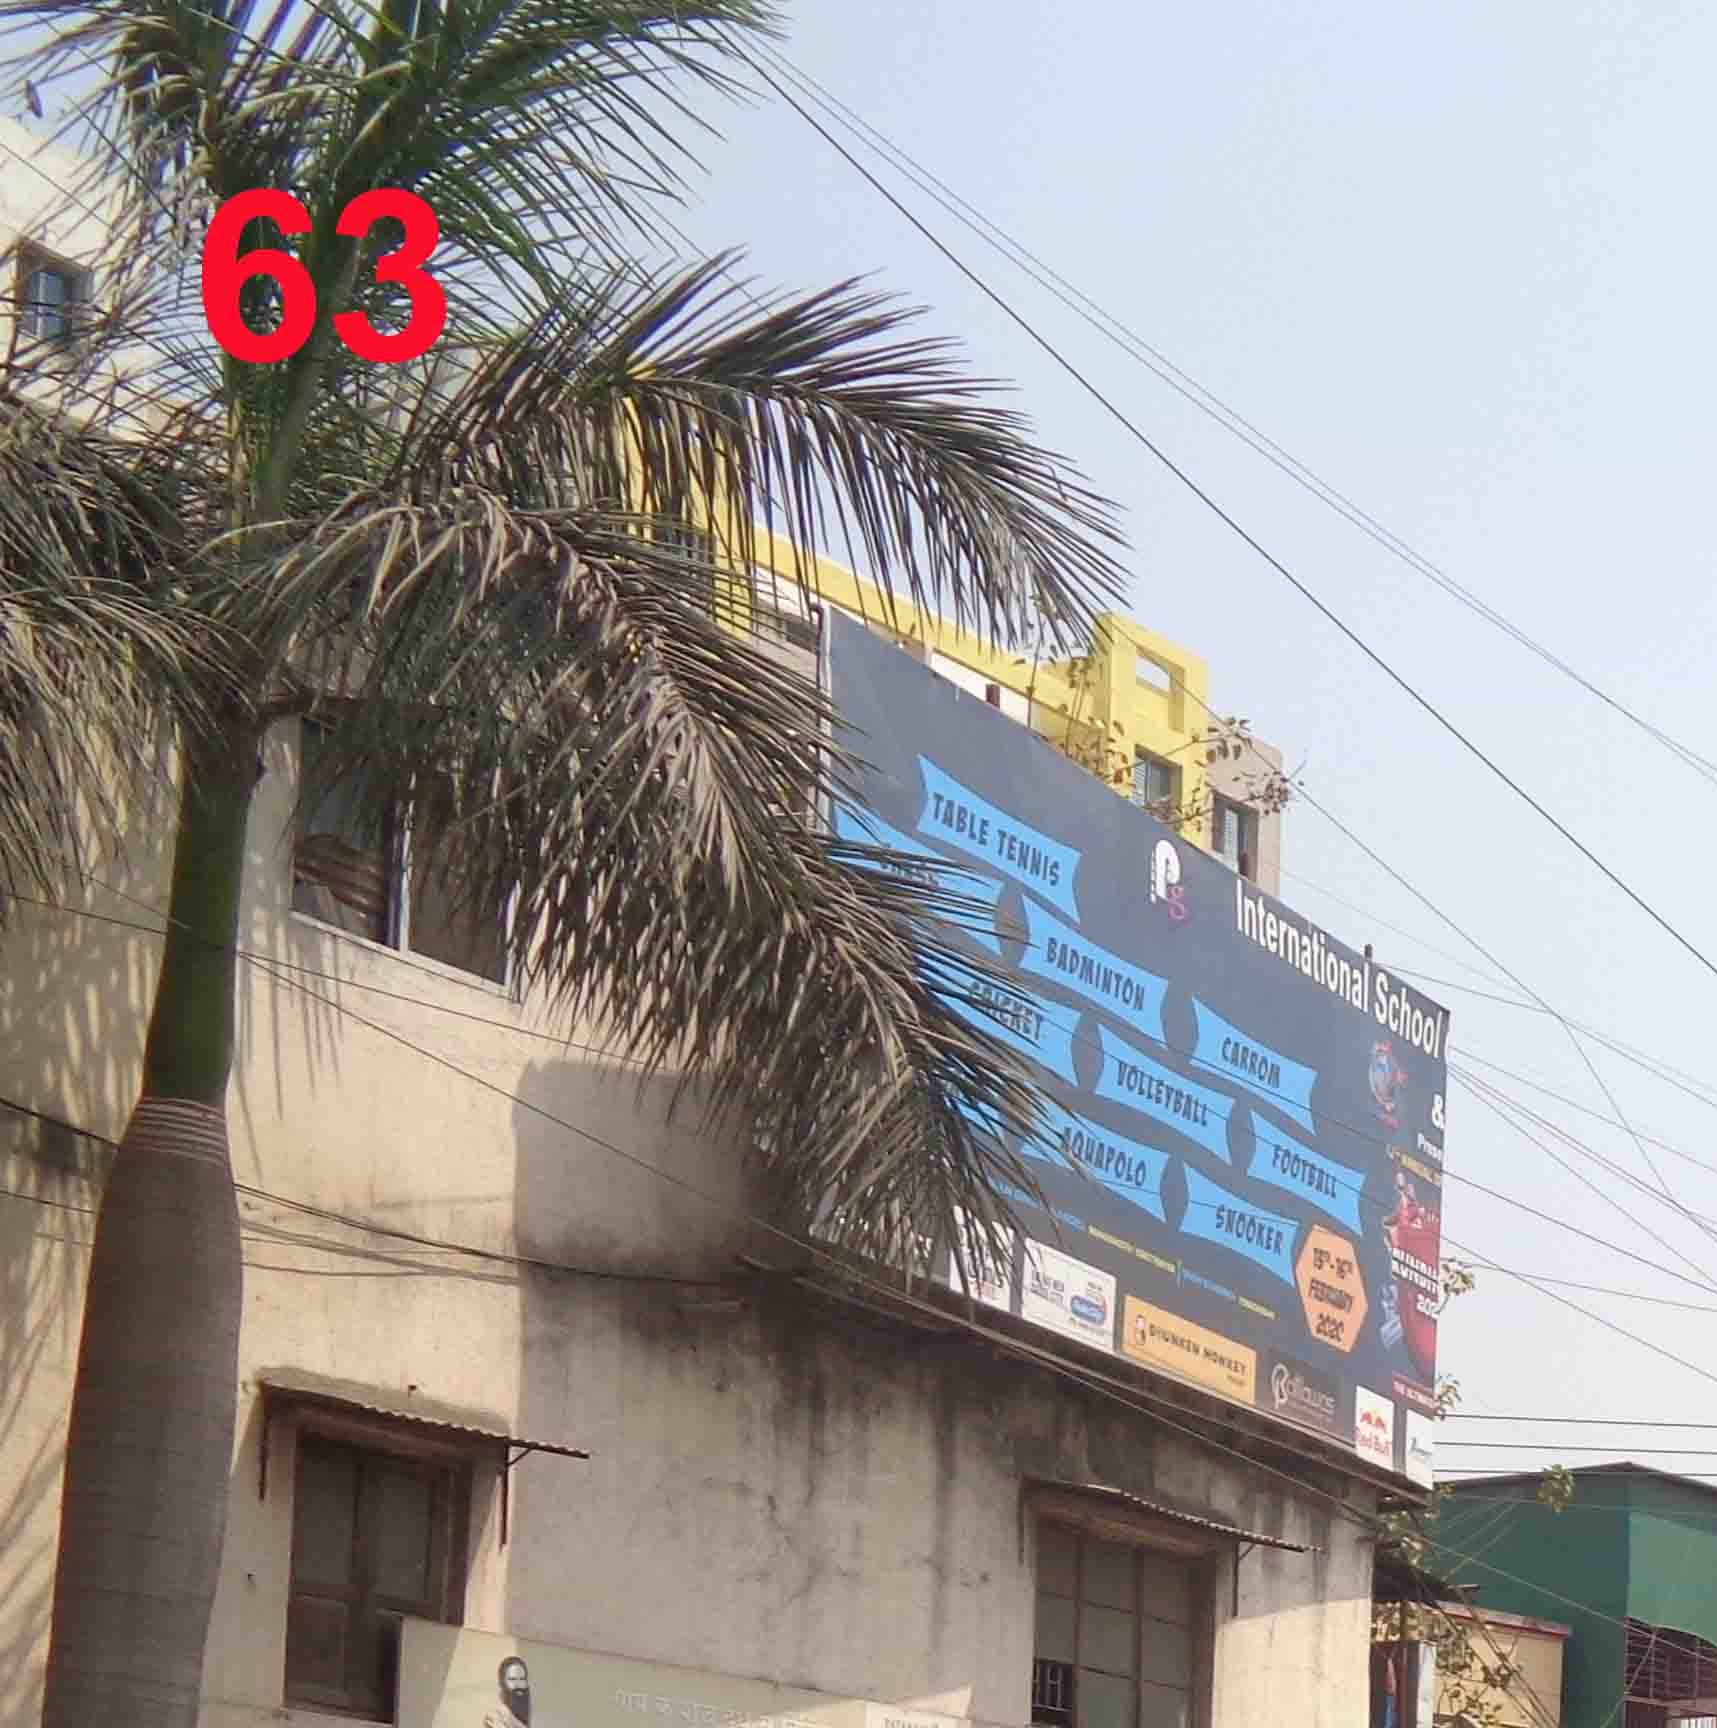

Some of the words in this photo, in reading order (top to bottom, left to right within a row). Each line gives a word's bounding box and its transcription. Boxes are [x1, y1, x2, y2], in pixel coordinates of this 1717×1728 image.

[932, 791, 989, 847] TABLE
[997, 829, 1061, 888] TENNIS
[1046, 936, 1146, 1014] BADMINTON
[1235, 879, 1369, 1014] International
[1374, 969, 1441, 1059] School
[1116, 1059, 1209, 1129] VOLLEYBALL
[1220, 1036, 1281, 1090] CARROM
[1062, 1126, 1148, 1188] AQUAPOLO
[1271, 1143, 1338, 1200] FOOTBALL
[1214, 1203, 1283, 1256] SNOOKER
